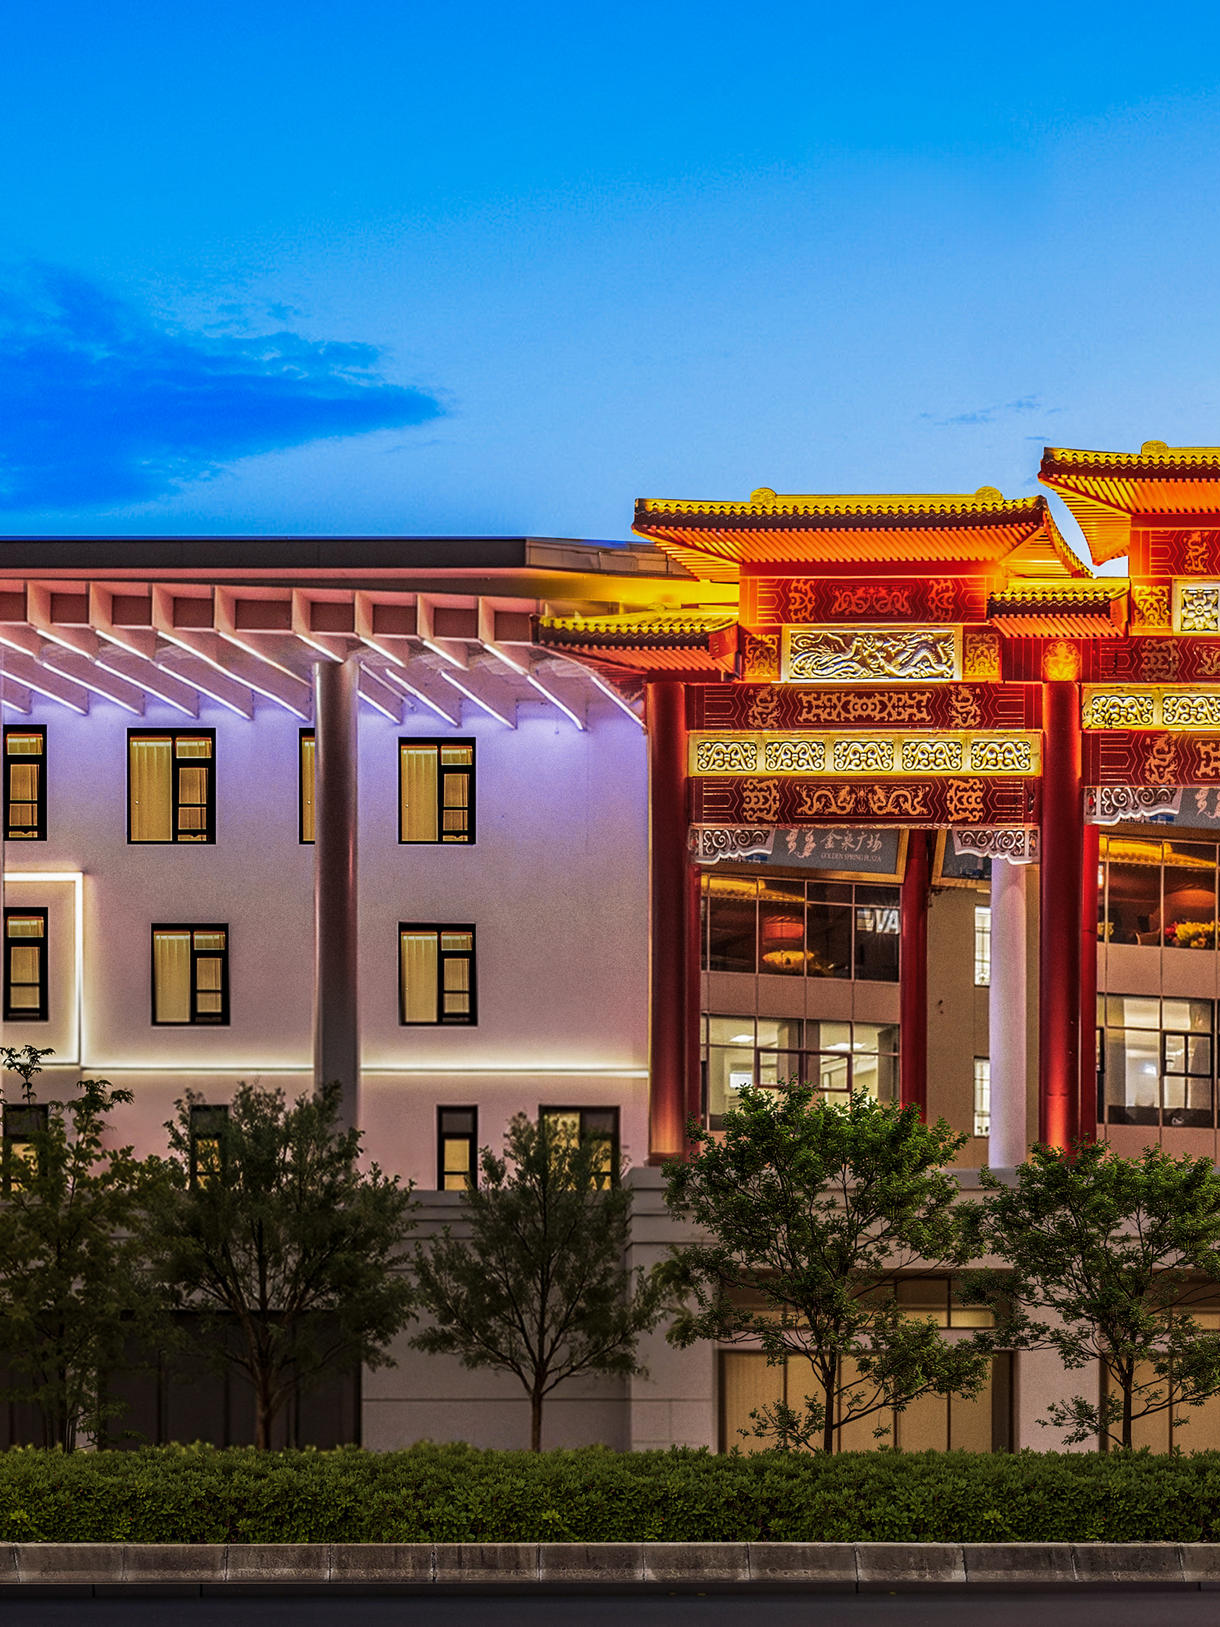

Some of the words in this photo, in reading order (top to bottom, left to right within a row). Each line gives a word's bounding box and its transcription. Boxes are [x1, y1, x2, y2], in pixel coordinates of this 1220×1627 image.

[820, 829, 883, 852] 金泉广场
[820, 852, 844, 860] GOLDEN
[843, 853, 863, 861] SPRING
[863, 855, 882, 863] PLAZA
